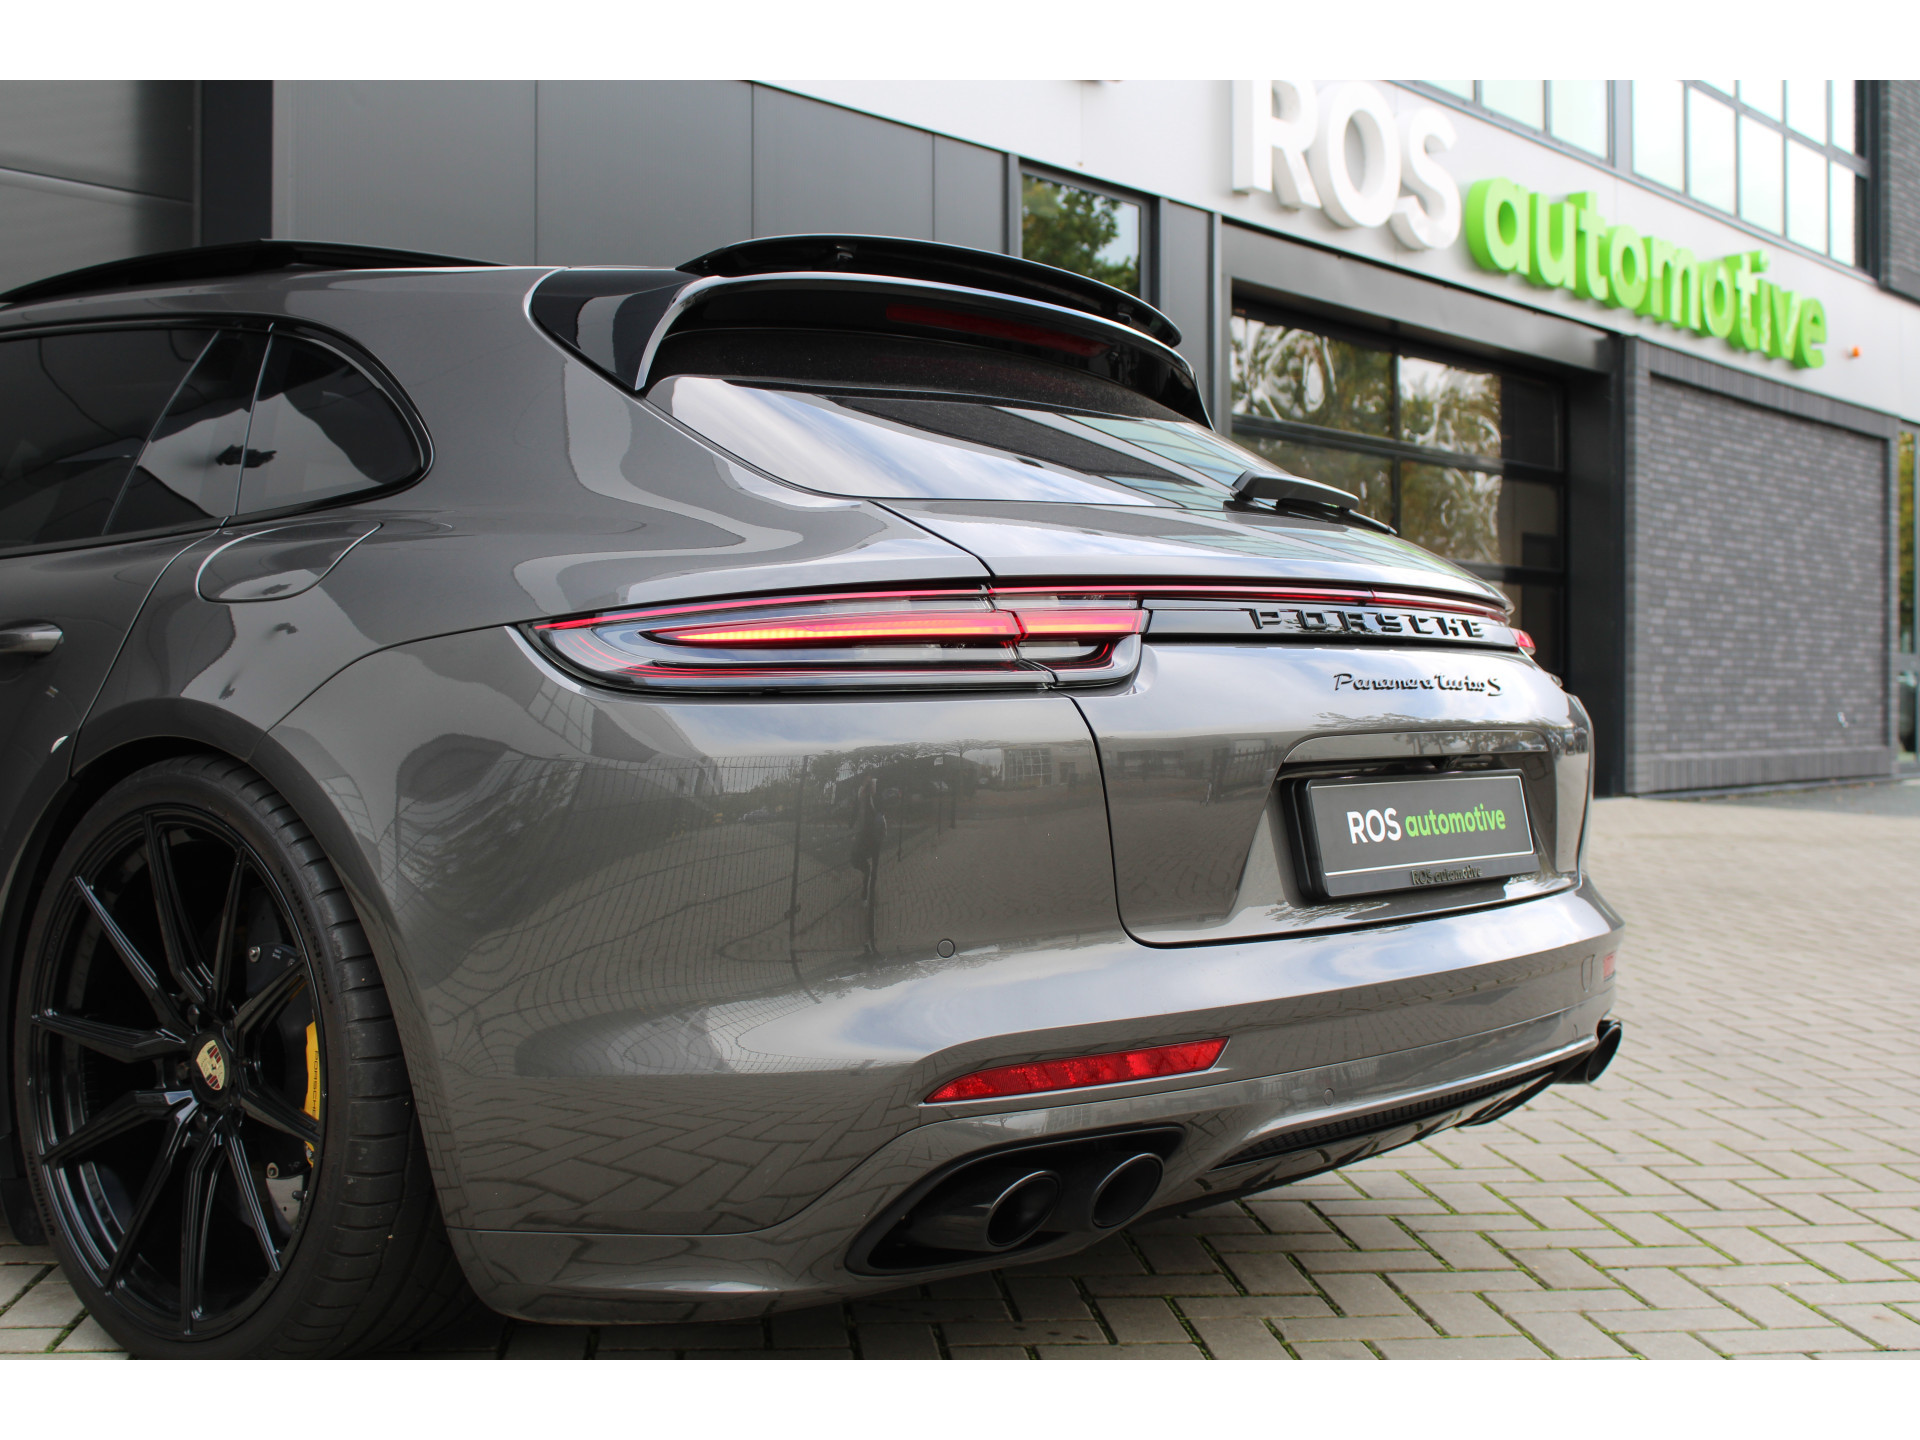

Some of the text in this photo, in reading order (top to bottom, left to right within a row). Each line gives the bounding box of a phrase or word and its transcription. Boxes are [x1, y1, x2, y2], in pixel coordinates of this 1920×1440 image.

[1232, 80, 1827, 369] ROS automotive
[1249, 608, 1485, 638] PORSCHE
[1333, 673, 1434, 691] Panamera
[1487, 678, 1503, 696] S
[1347, 803, 1507, 844] ROS automotive
[1411, 865, 1482, 885] ROS automotive
[311, 1050, 320, 1117] PORSCHE
